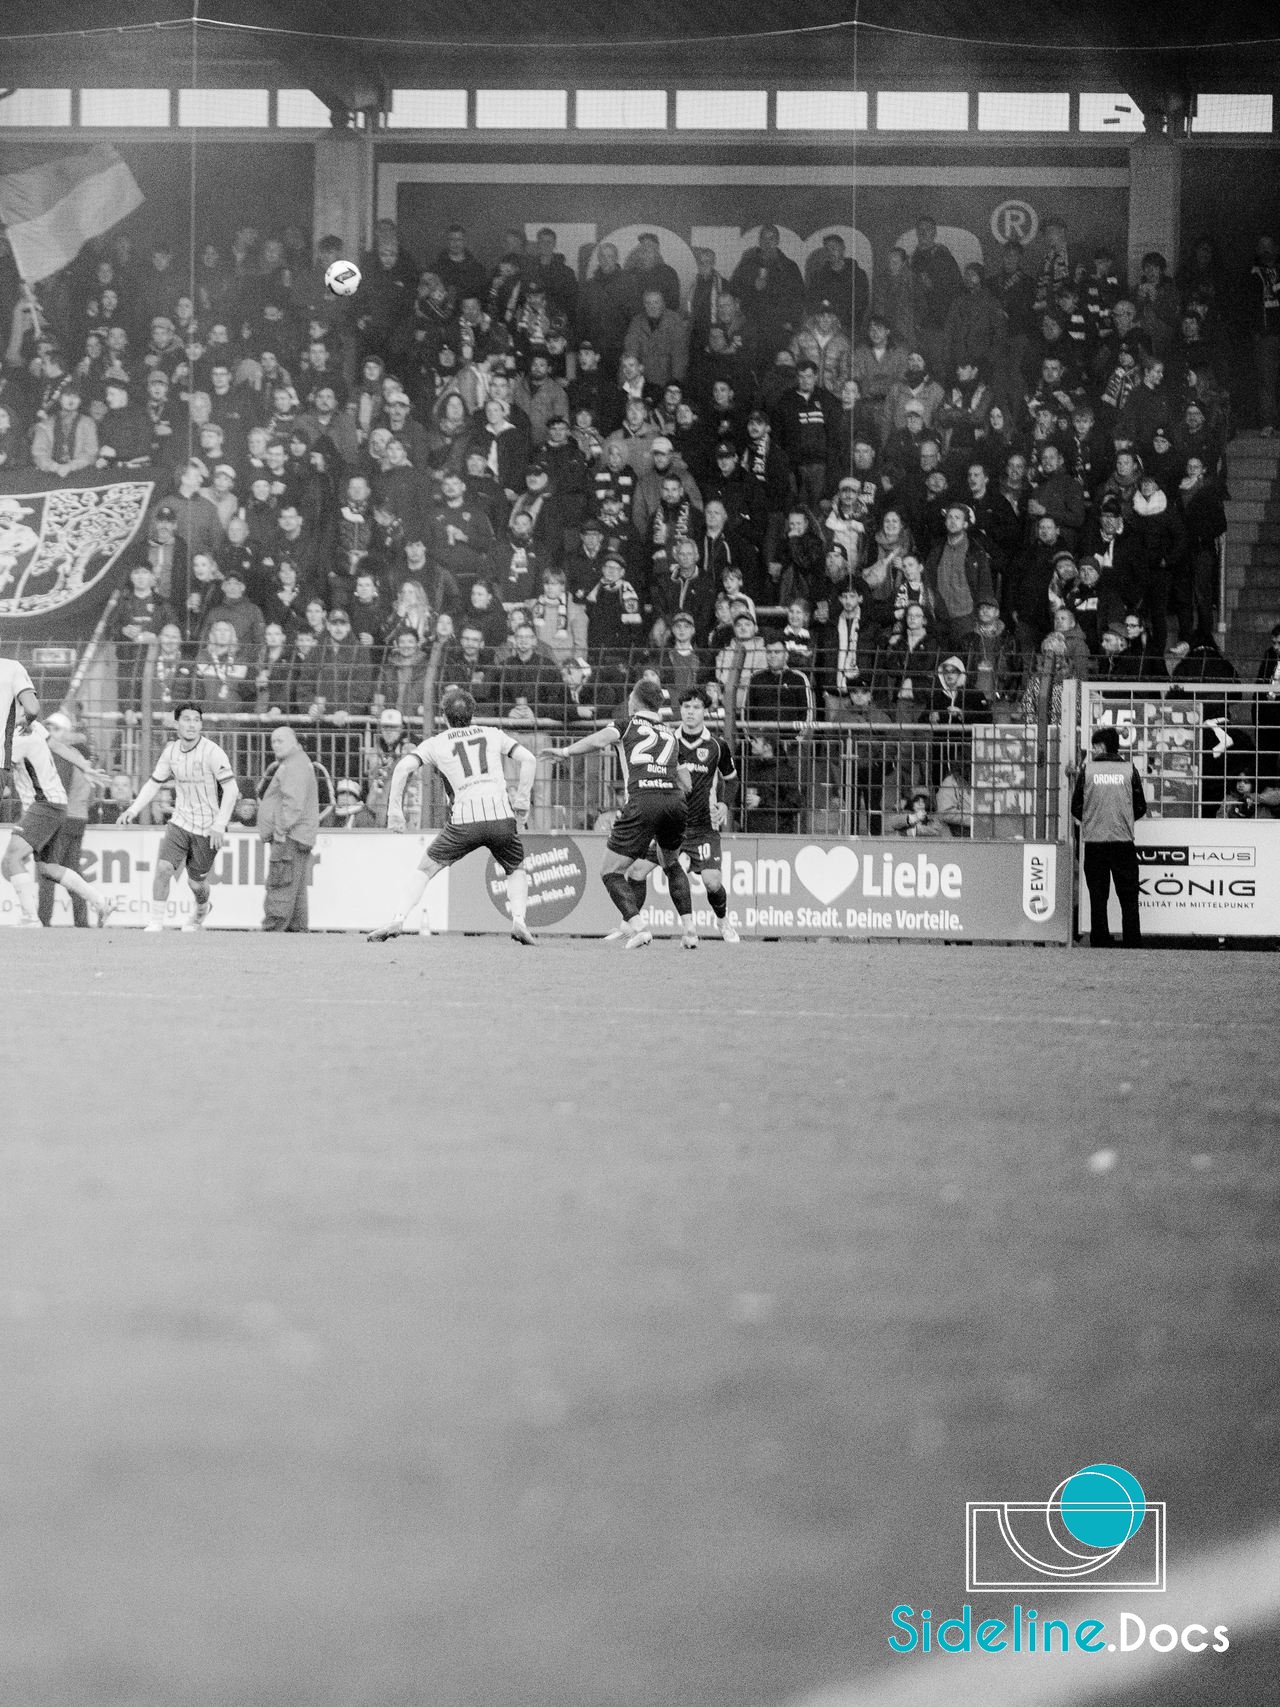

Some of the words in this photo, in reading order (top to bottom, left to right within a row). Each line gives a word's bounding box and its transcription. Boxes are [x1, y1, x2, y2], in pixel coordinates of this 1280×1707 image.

[452, 736, 488, 777] 17
[630, 725, 675, 766] 27
[1093, 773, 1125, 785] ORDNER
[697, 842, 711, 861] 10
[1192, 850, 1251, 862] HAUS
[862, 853, 963, 898] Liebe
[1030, 856, 1044, 891] EWP
[639, 905, 674, 927] eine
[746, 905, 793, 928] Deine
[797, 907, 842, 930] Stadt.
[846, 908, 893, 930] Deine
[896, 908, 963, 932] Vorteile.
[1175, 901, 1186, 909] IM
[1190, 901, 1255, 910] MITTELPUNKT
